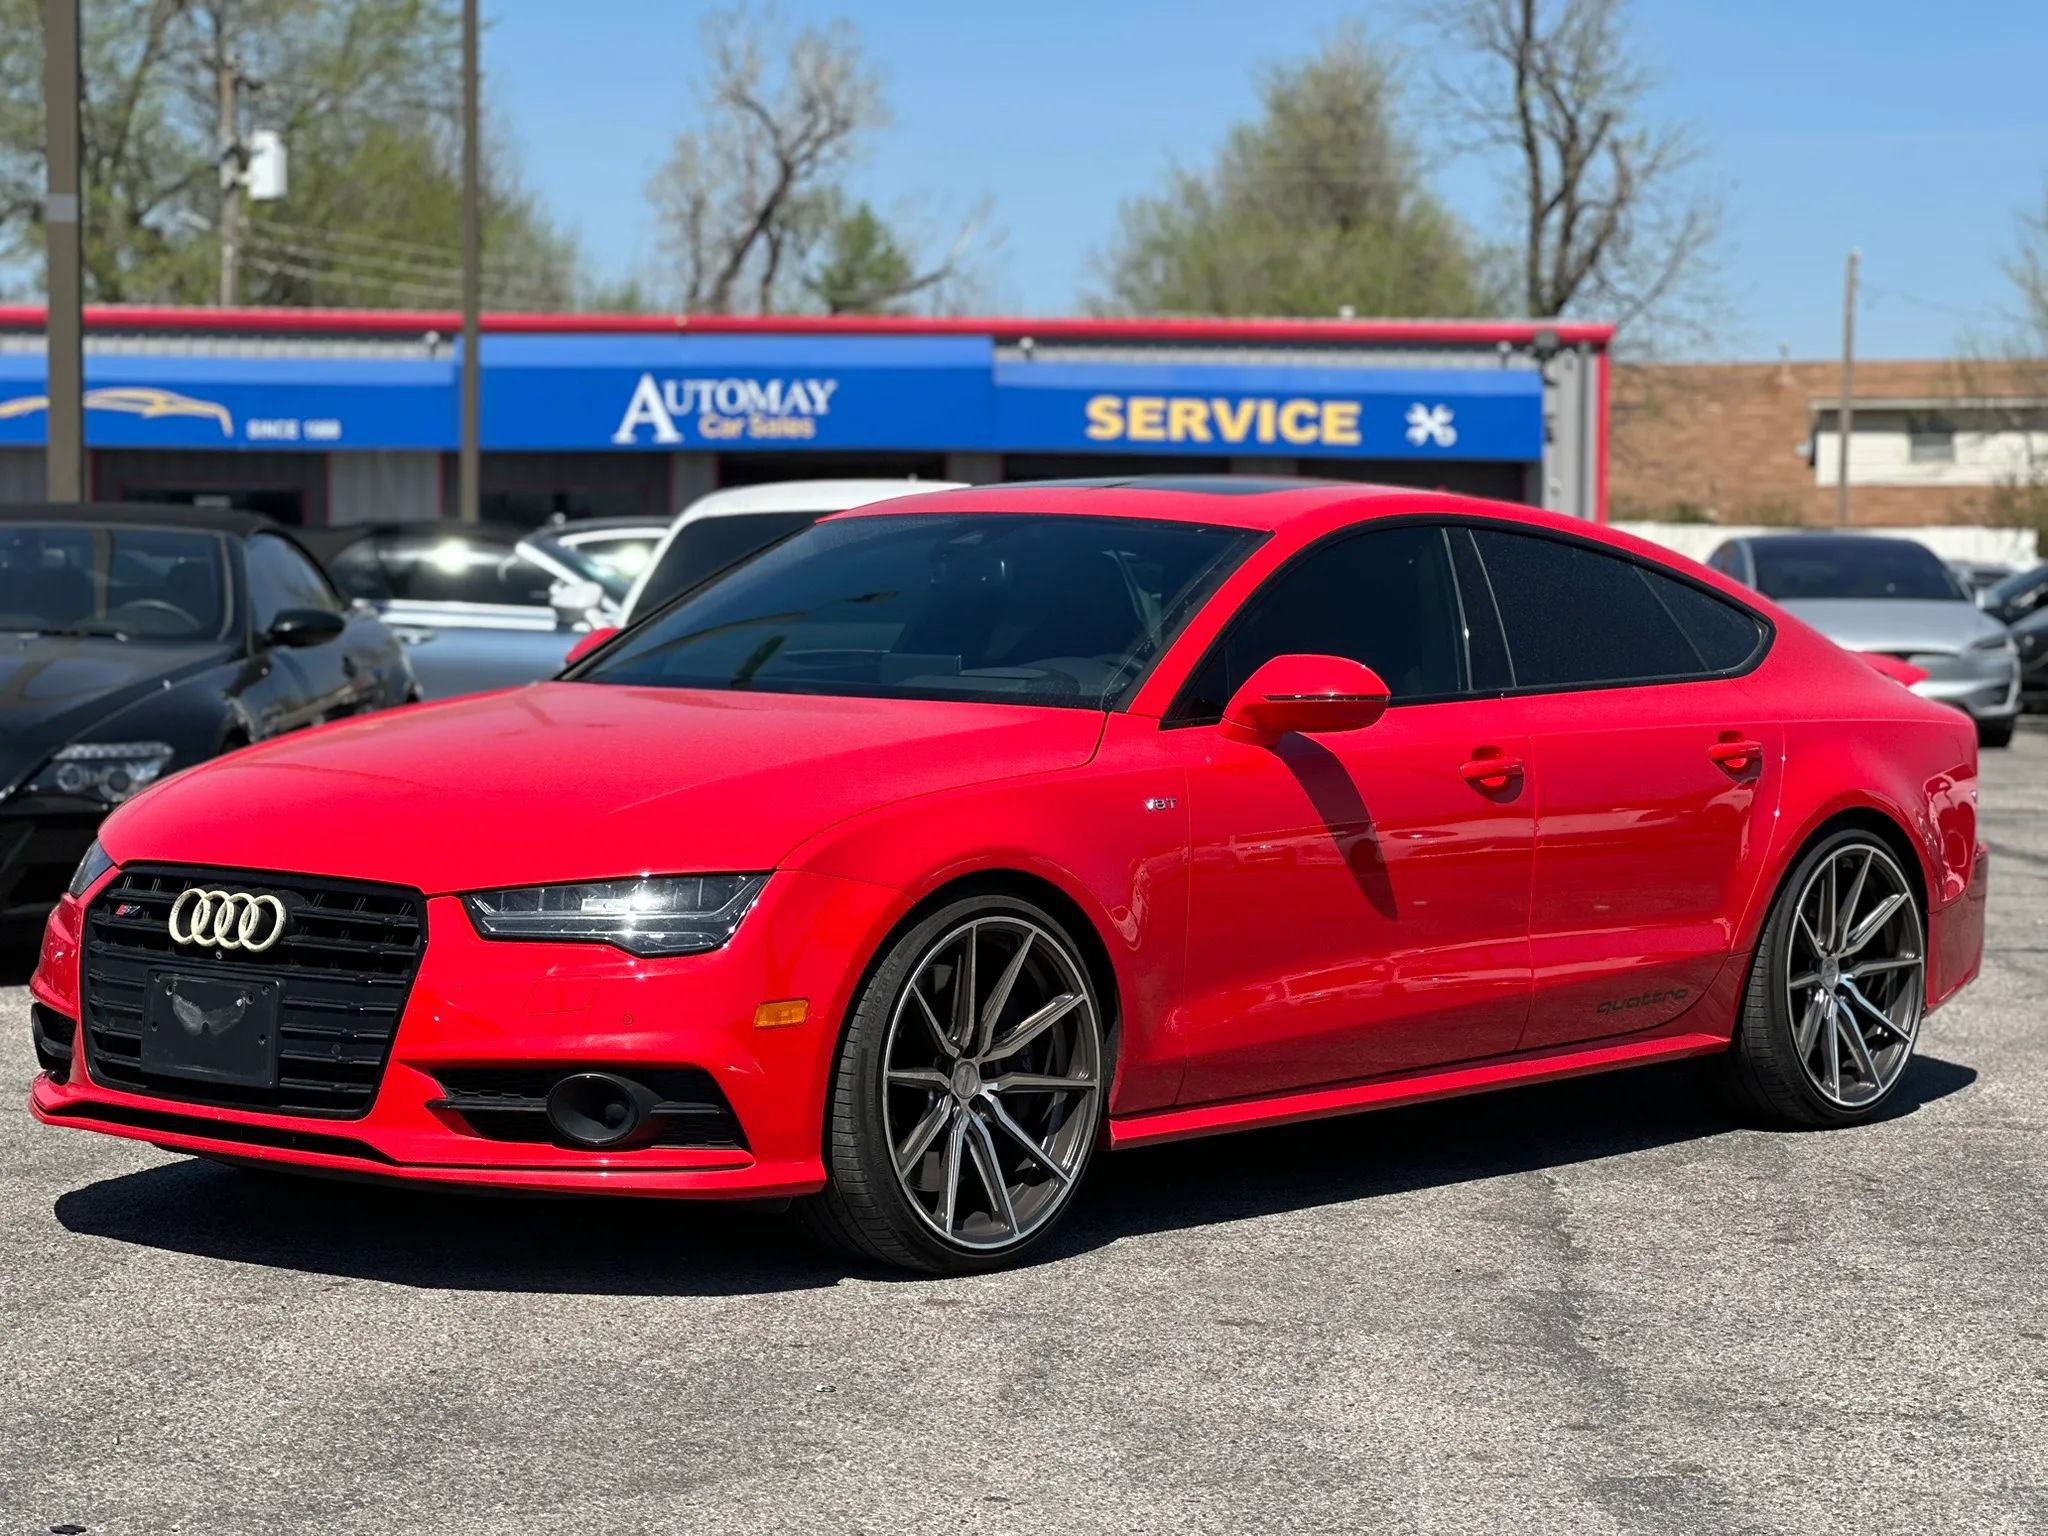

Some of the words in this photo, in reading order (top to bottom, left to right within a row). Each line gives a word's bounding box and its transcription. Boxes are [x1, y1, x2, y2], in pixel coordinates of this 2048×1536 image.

[611, 372, 838, 444] AUTOMAY
[1086, 395, 1361, 446] SERVICE
[246, 418, 299, 440] SINCE
[698, 412, 744, 439] Car
[748, 412, 816, 439] Sales
[1596, 988, 1689, 1016] quattro
